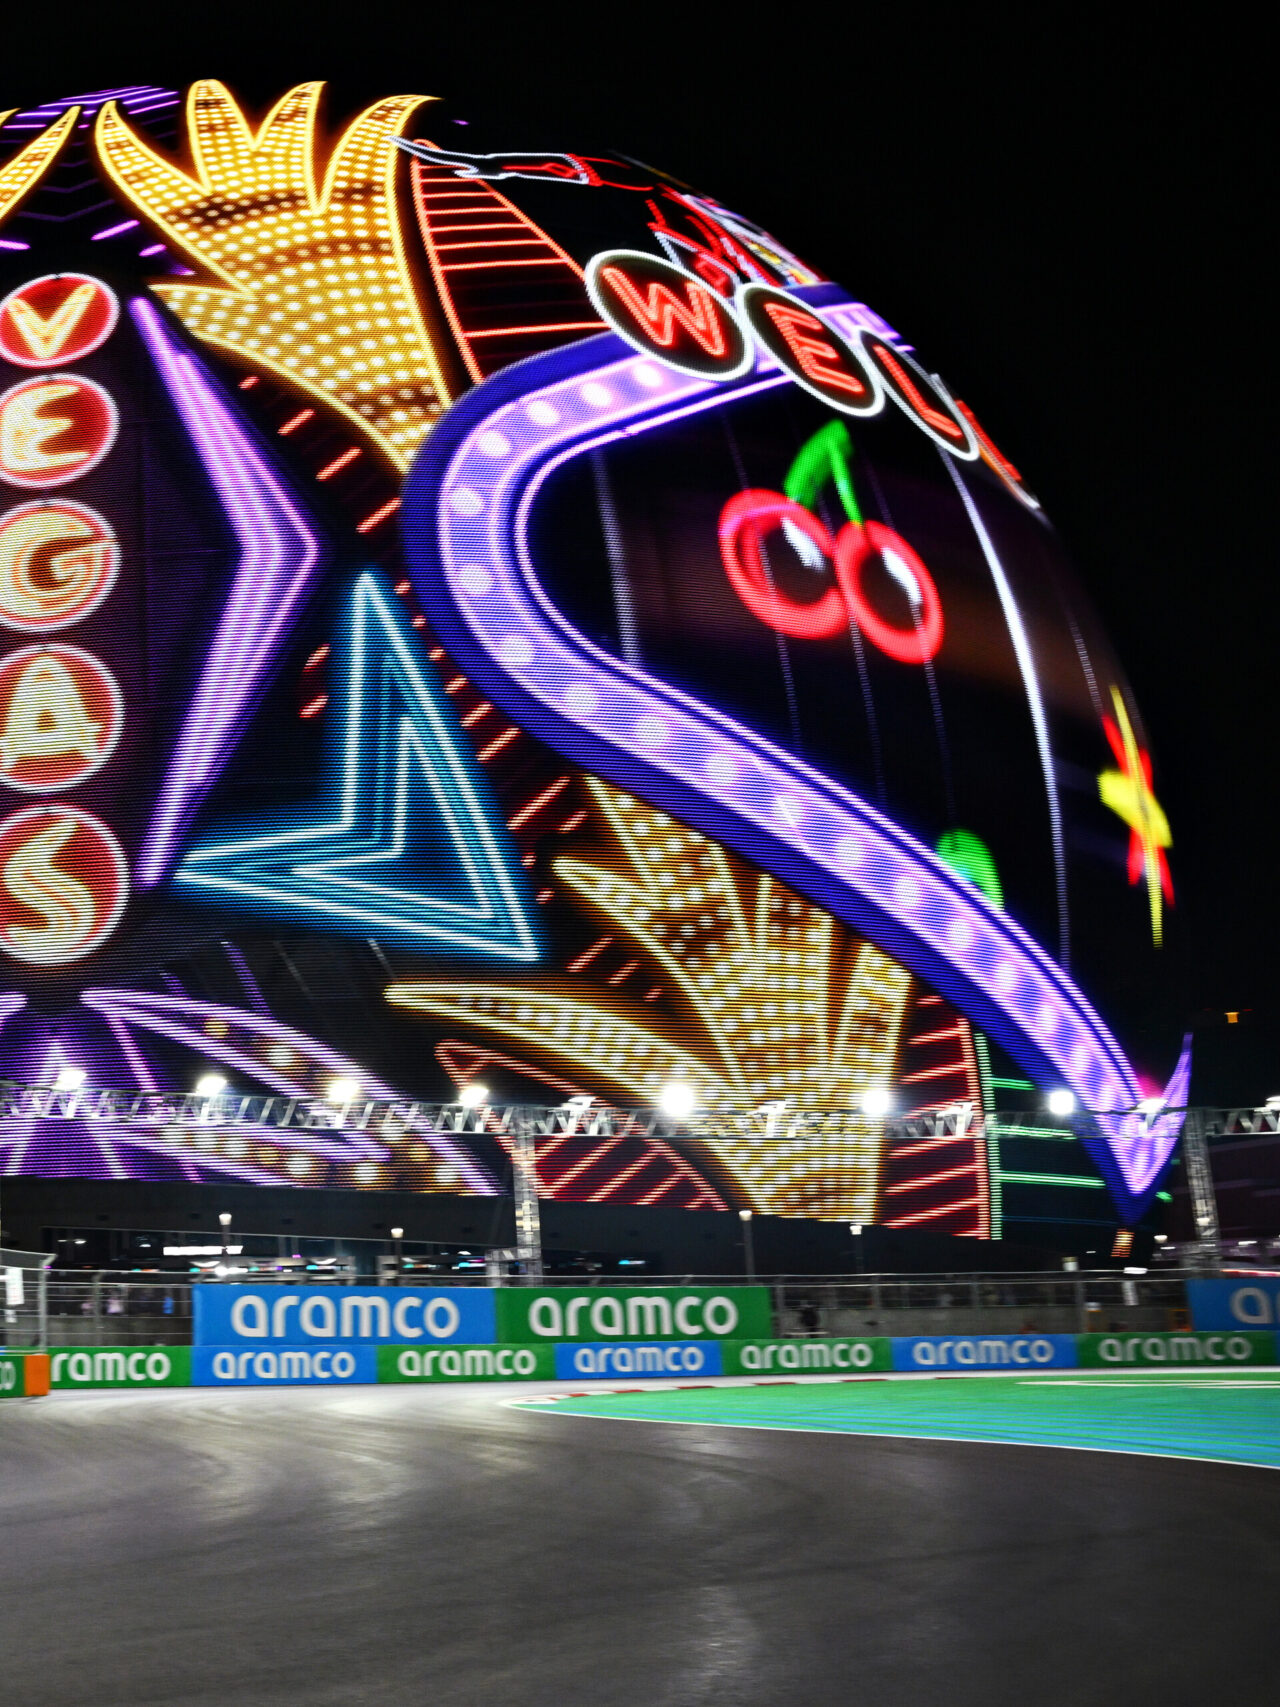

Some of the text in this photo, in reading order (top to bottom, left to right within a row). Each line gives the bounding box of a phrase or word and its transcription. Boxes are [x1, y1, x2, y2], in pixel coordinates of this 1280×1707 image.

[231, 1295, 460, 1338] aramco
[528, 1296, 738, 1337] aramco
[397, 1350, 537, 1377] aramco
[574, 1347, 704, 1373] aramco
[740, 1343, 873, 1369] aramco
[913, 1339, 1055, 1365] aramco
[1098, 1337, 1252, 1363] aramco
[51, 1352, 171, 1382] ramco
[212, 1351, 356, 1379] aramco
